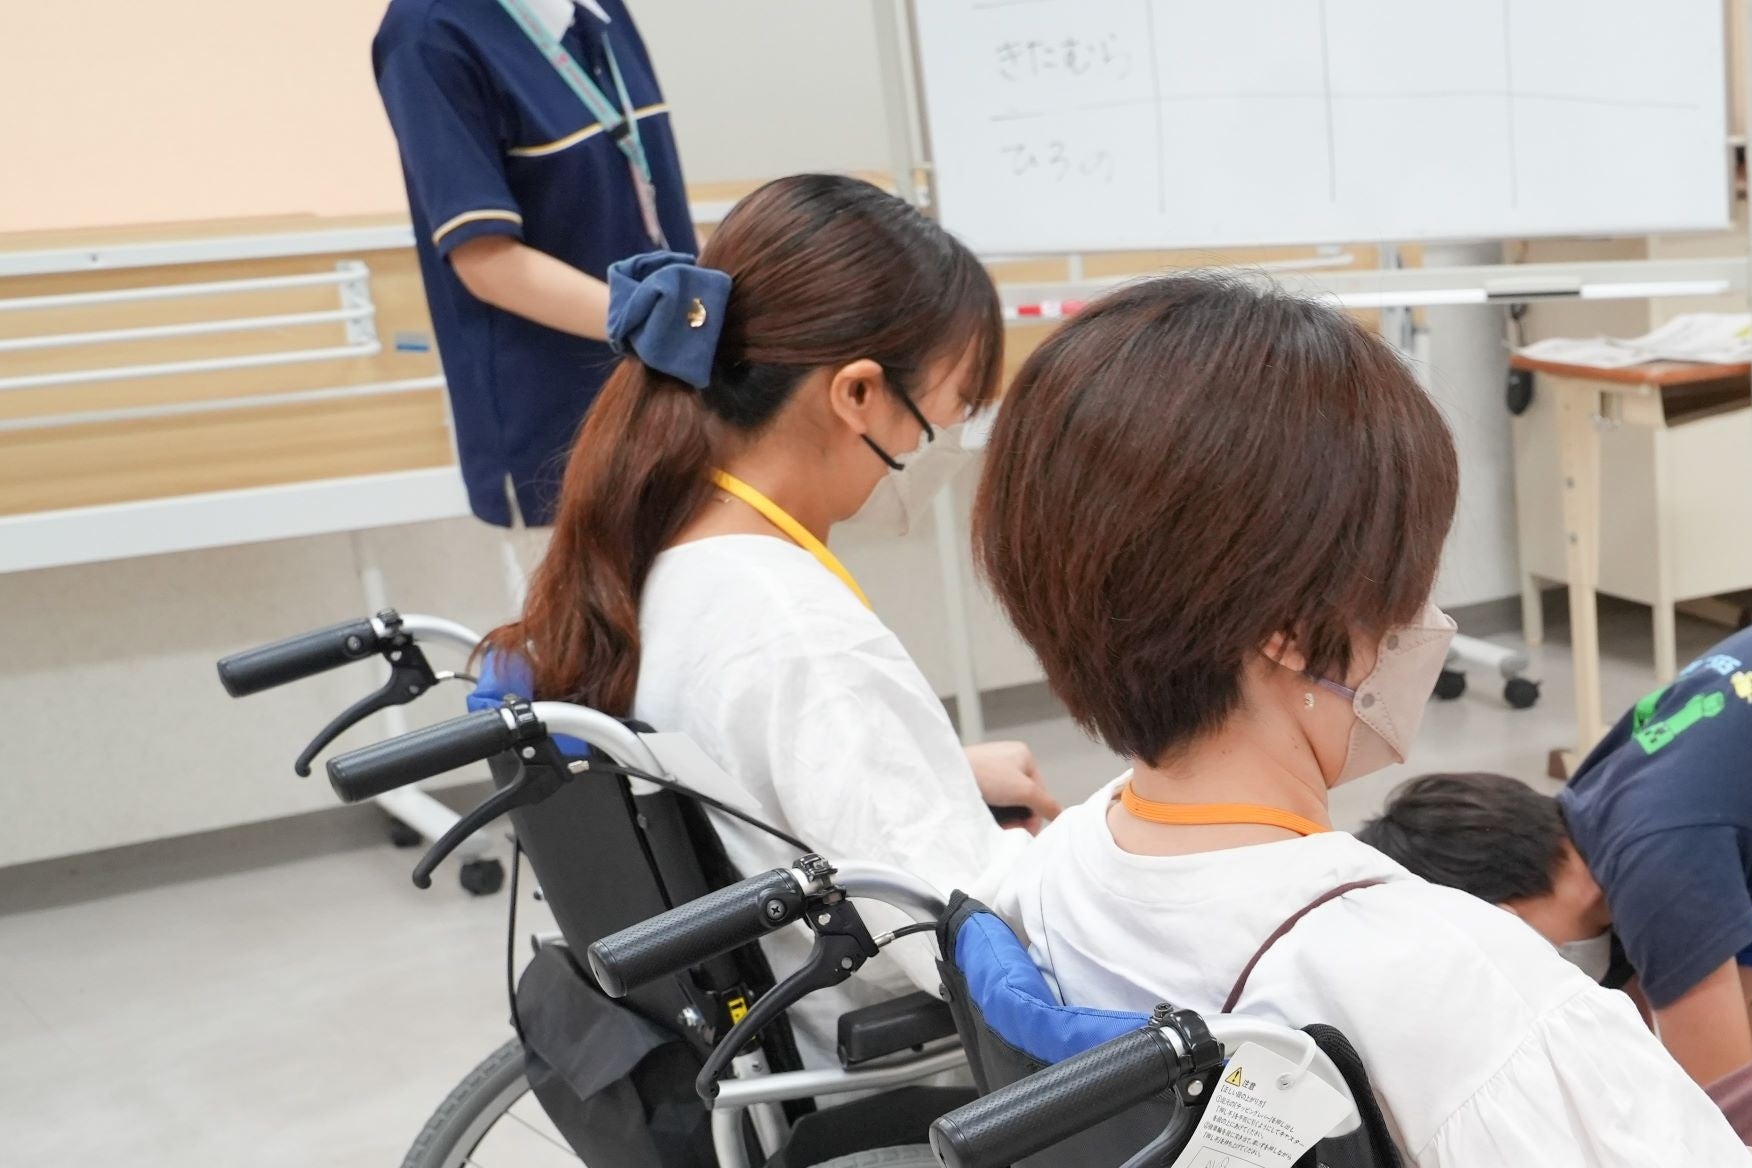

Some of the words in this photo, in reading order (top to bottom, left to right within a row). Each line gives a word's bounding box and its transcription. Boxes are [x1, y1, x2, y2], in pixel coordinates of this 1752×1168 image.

[996, 31, 1133, 82] きたむら
[1242, 1079, 1257, 1091] 注意
